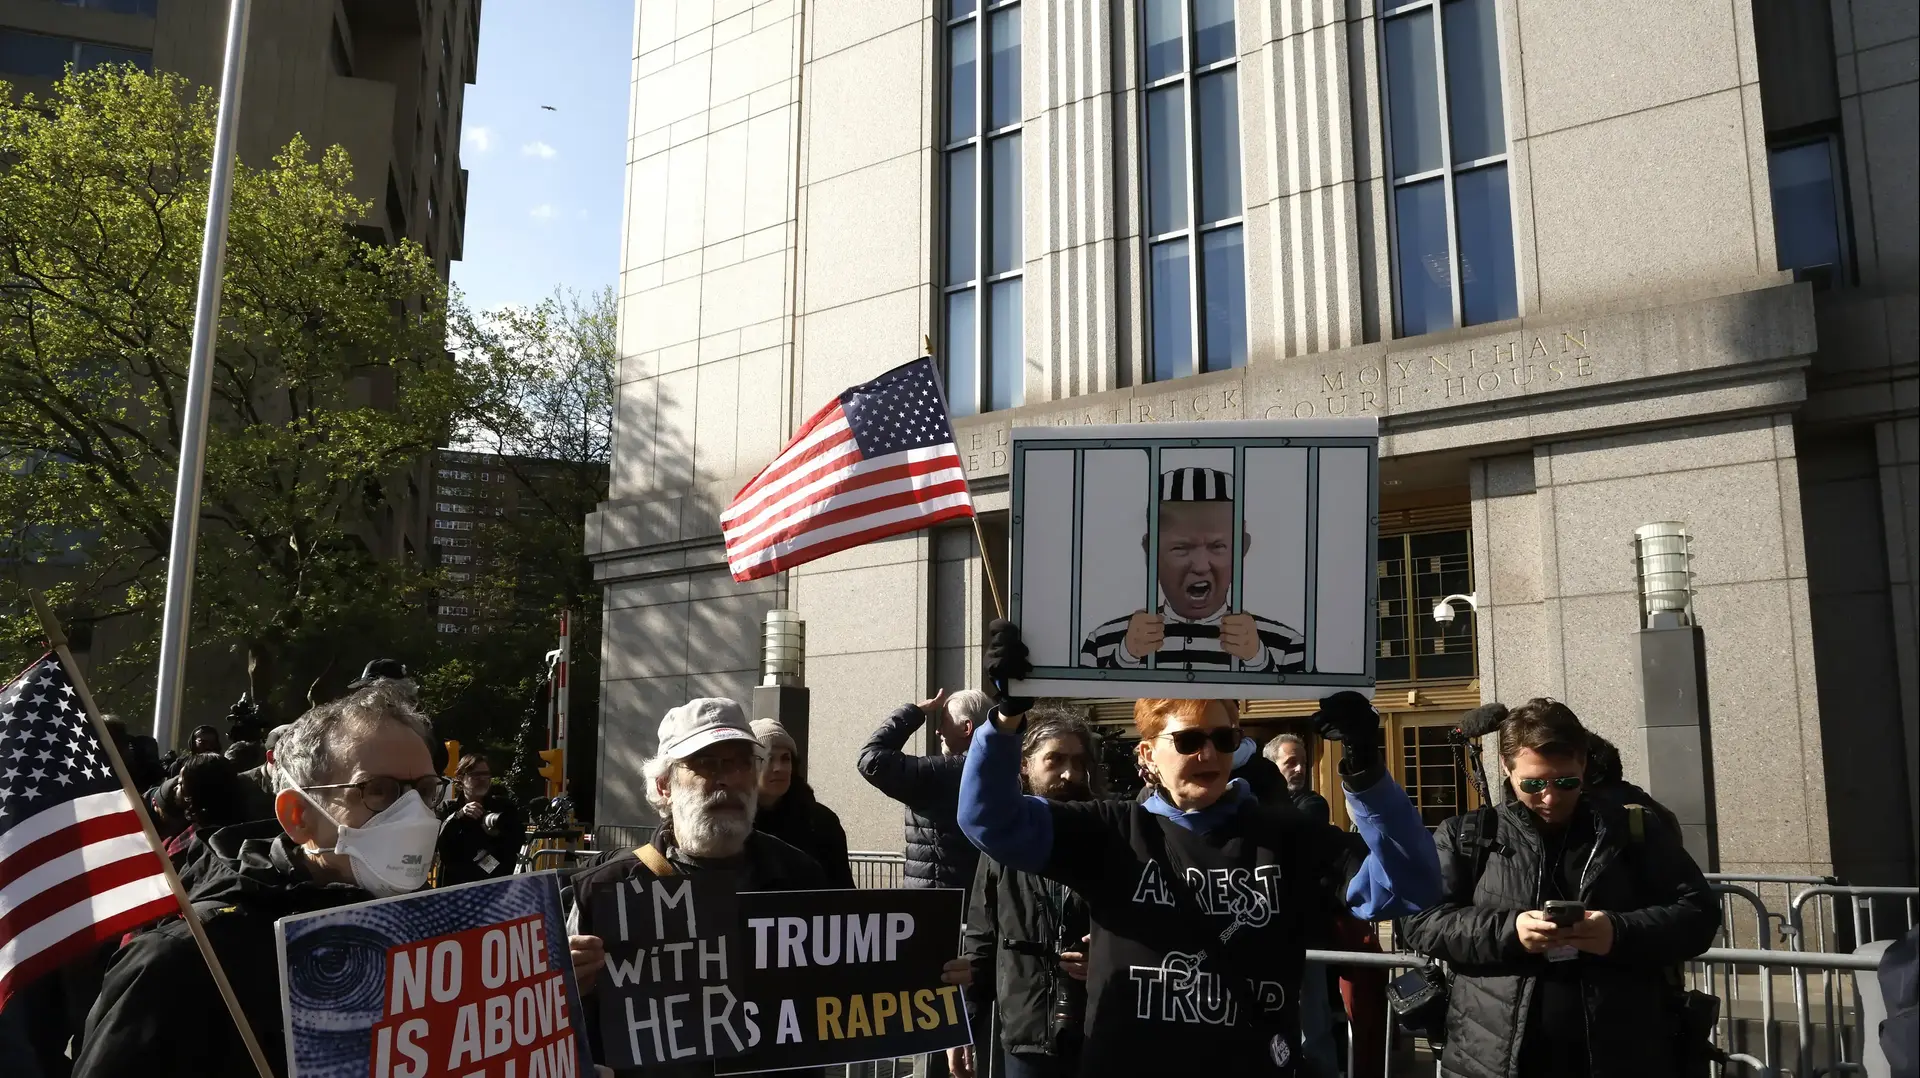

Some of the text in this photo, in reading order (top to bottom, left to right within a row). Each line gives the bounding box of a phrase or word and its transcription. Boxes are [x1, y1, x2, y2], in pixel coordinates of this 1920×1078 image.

[1265, 356, 1593, 420] COURT HOUSE
[1321, 329, 1588, 393] MOYNIHAN
[401, 854, 423, 865] 3M
[1132, 858, 1282, 917] AREST
[615, 878, 698, 942] I'M
[747, 912, 916, 970] TRUMP
[390, 919, 548, 1017] NO ONE
[375, 975, 571, 1078] IS ABOVE
[624, 984, 746, 1066] HER
[775, 998, 804, 1046] A
[815, 985, 960, 1041] RAPIST
